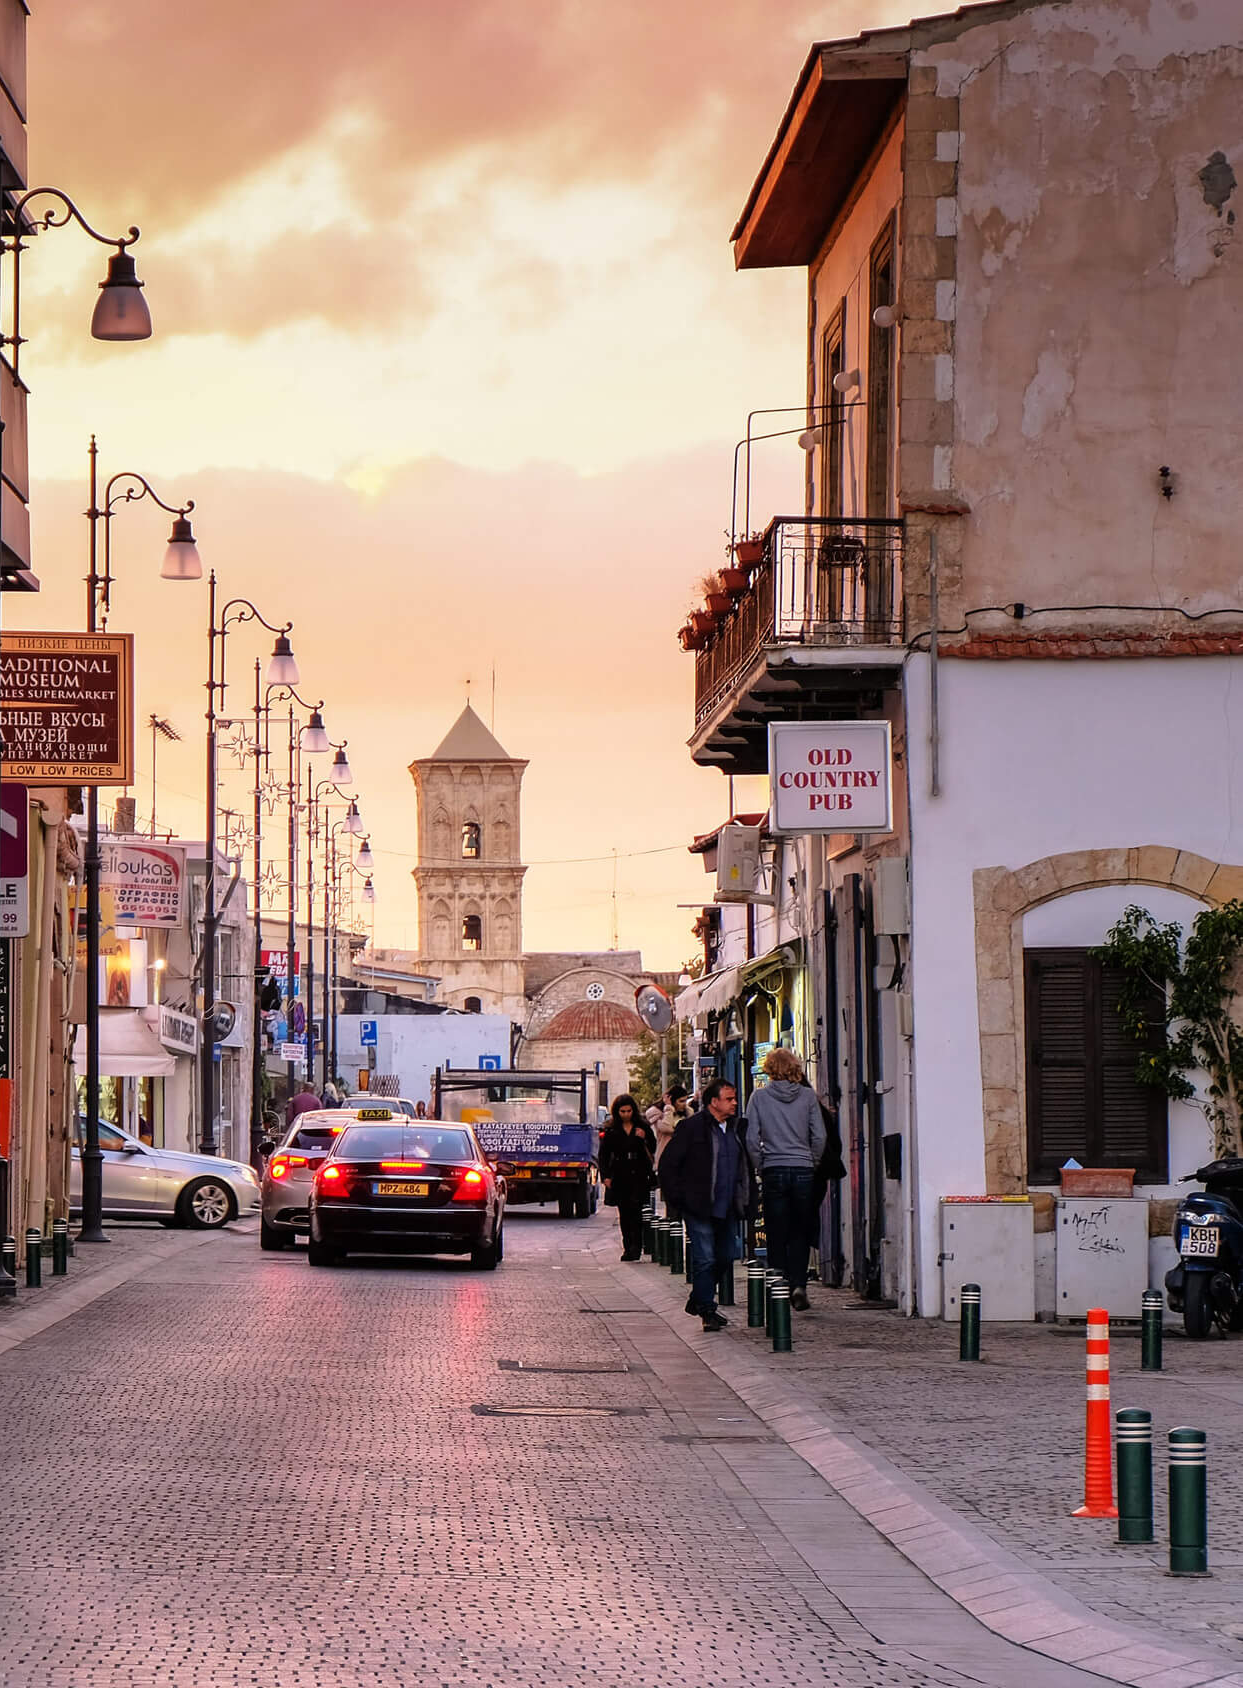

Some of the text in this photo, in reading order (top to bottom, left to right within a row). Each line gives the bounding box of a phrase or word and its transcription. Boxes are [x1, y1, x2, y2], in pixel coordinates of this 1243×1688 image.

[18, 639, 111, 650] НИЗКИЕ ЦЕНЫ
[0, 673, 80, 688] MUSEUM
[28, 689, 116, 700] SUPERMARKET
[51, 712, 105, 727] ВКУСЫ
[14, 727, 68, 743] МУЗЕЙ
[59, 743, 108, 753] ОВОЩИ
[40, 752, 94, 760] МАРКЕТ
[808, 748, 852, 766] OLD
[10, 766, 113, 776] LOW LOW PRICES
[779, 770, 881, 789] COUNTRY
[809, 793, 853, 811] PUB
[403, 1184, 421, 1193] 484
[1190, 1228, 1217, 1241] KBH
[1189, 1242, 1216, 1254] 508
